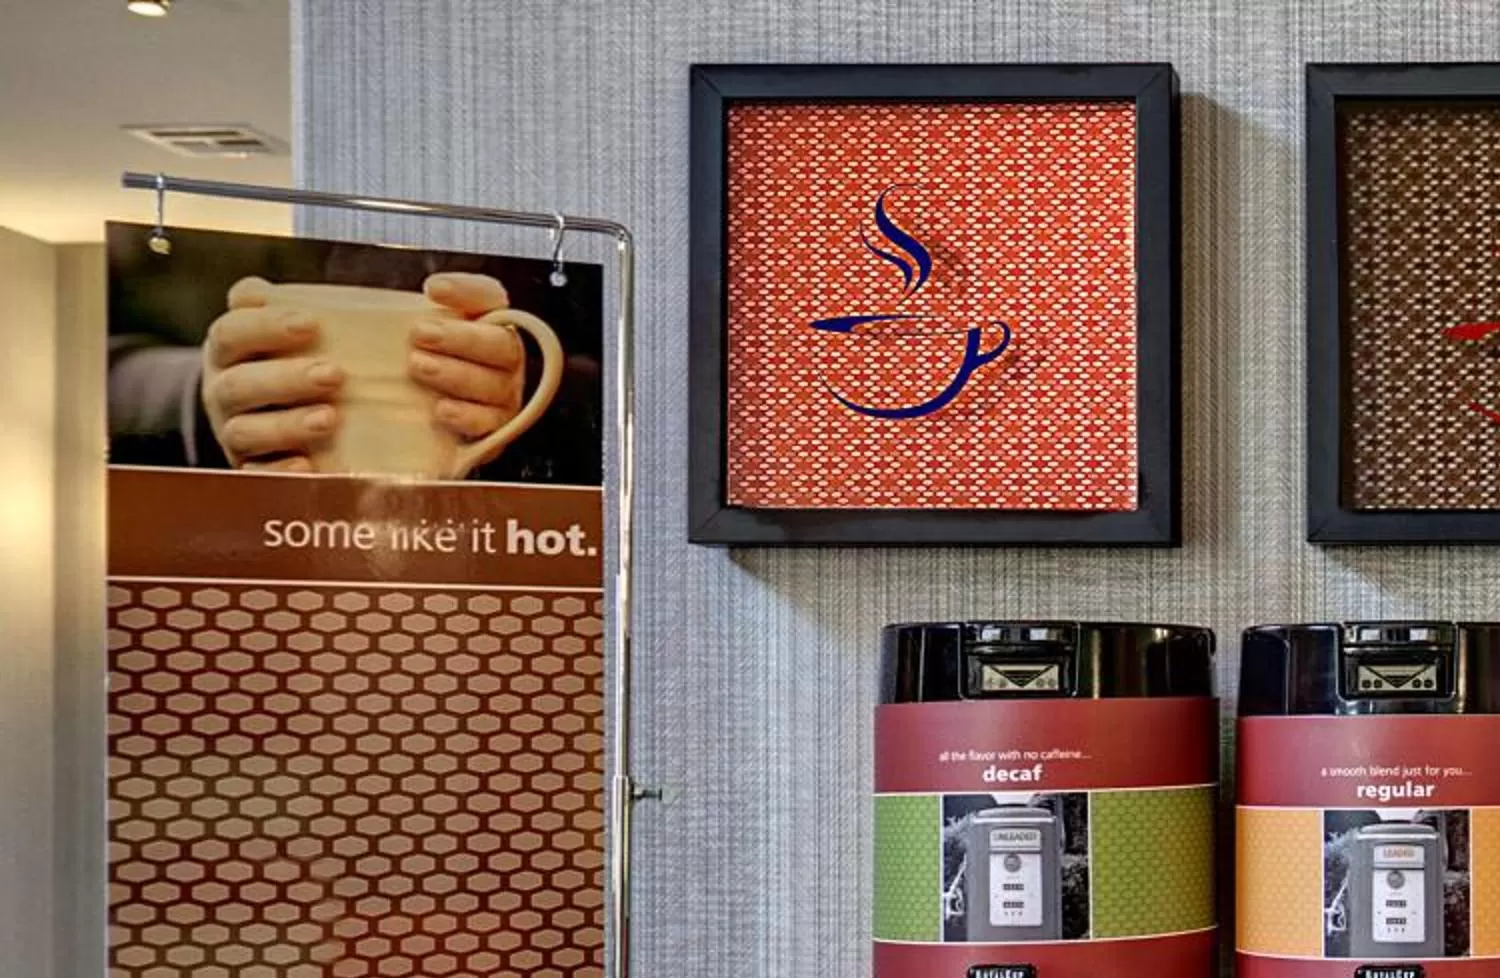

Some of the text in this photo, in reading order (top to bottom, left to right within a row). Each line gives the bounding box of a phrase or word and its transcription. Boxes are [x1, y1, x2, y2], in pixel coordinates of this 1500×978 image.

[264, 519, 376, 549] some
[472, 518, 497, 554] it
[506, 518, 598, 557] hot.
[951, 751, 966, 761] the
[968, 750, 995, 761] flavor
[999, 749, 1021, 760] with
[1023, 750, 1037, 759] no
[982, 764, 1043, 782] decaf
[1329, 765, 1367, 776] smooth
[1369, 765, 1400, 776] blend
[1401, 765, 1422, 778] just
[1425, 764, 1440, 776] for
[1356, 781, 1435, 801] regular
